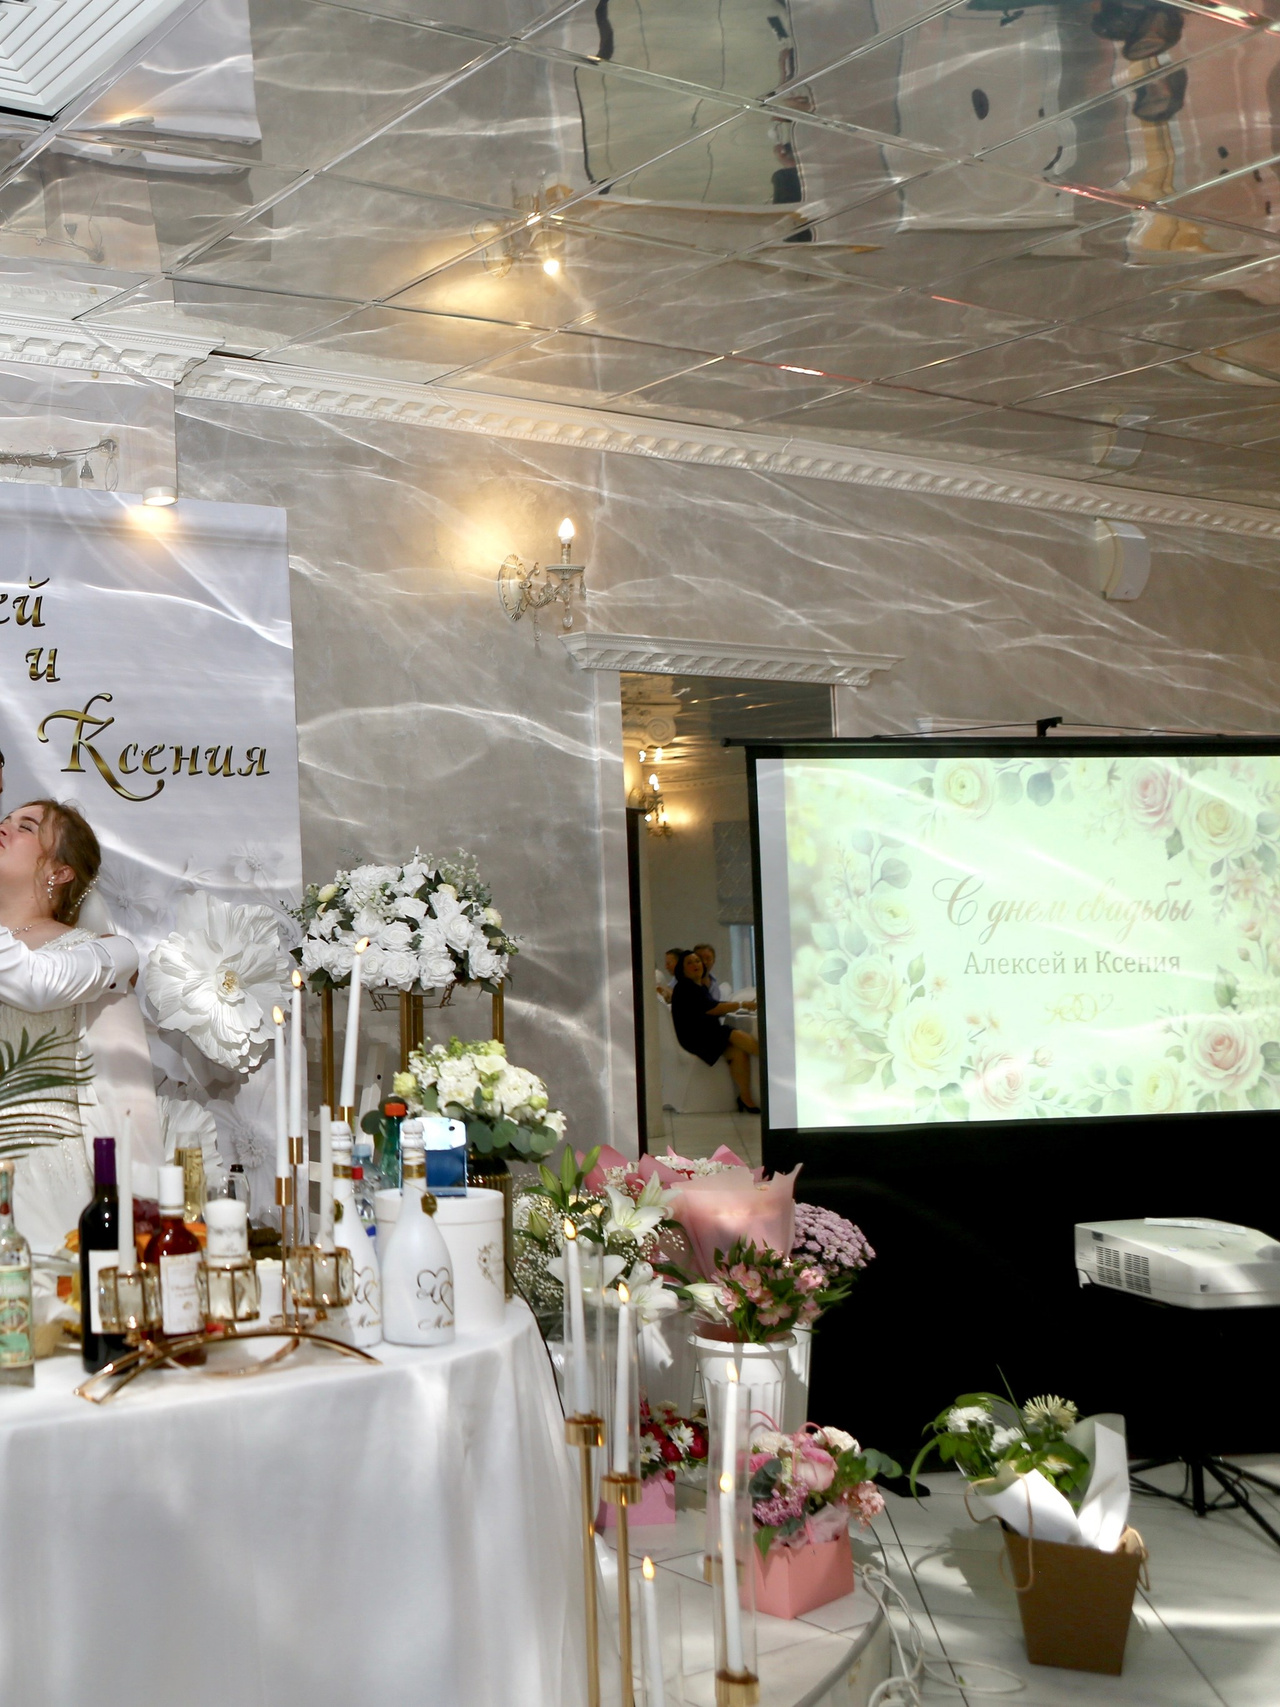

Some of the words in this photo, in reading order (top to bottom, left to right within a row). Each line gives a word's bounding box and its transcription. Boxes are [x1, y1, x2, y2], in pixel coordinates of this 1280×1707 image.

[25, 647, 61, 683] и
[36, 692, 270, 802] Ксения
[932, 874, 985, 927] С
[978, 899, 1069, 946] днем
[1075, 877, 1196, 944] свадьбы
[963, 951, 1066, 975] Алексей
[1073, 956, 1089, 974] и
[1095, 951, 1181, 974] Ксения
